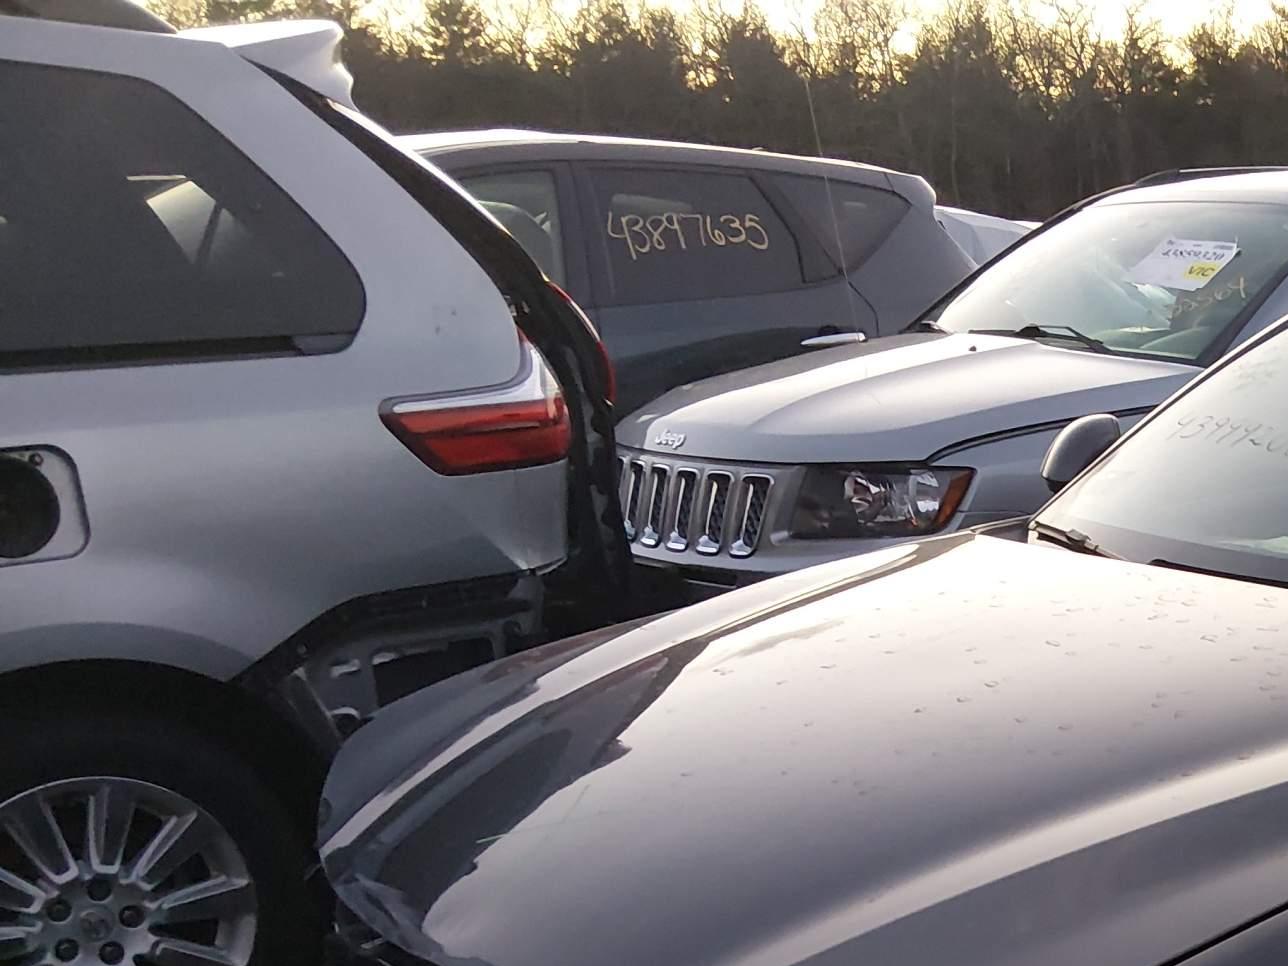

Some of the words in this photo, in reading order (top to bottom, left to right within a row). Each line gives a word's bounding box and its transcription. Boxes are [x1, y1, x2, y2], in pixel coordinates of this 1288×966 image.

[607, 211, 769, 261] 43897635
[1188, 265, 1215, 277] VIC
[655, 429, 687, 449] Jeep
